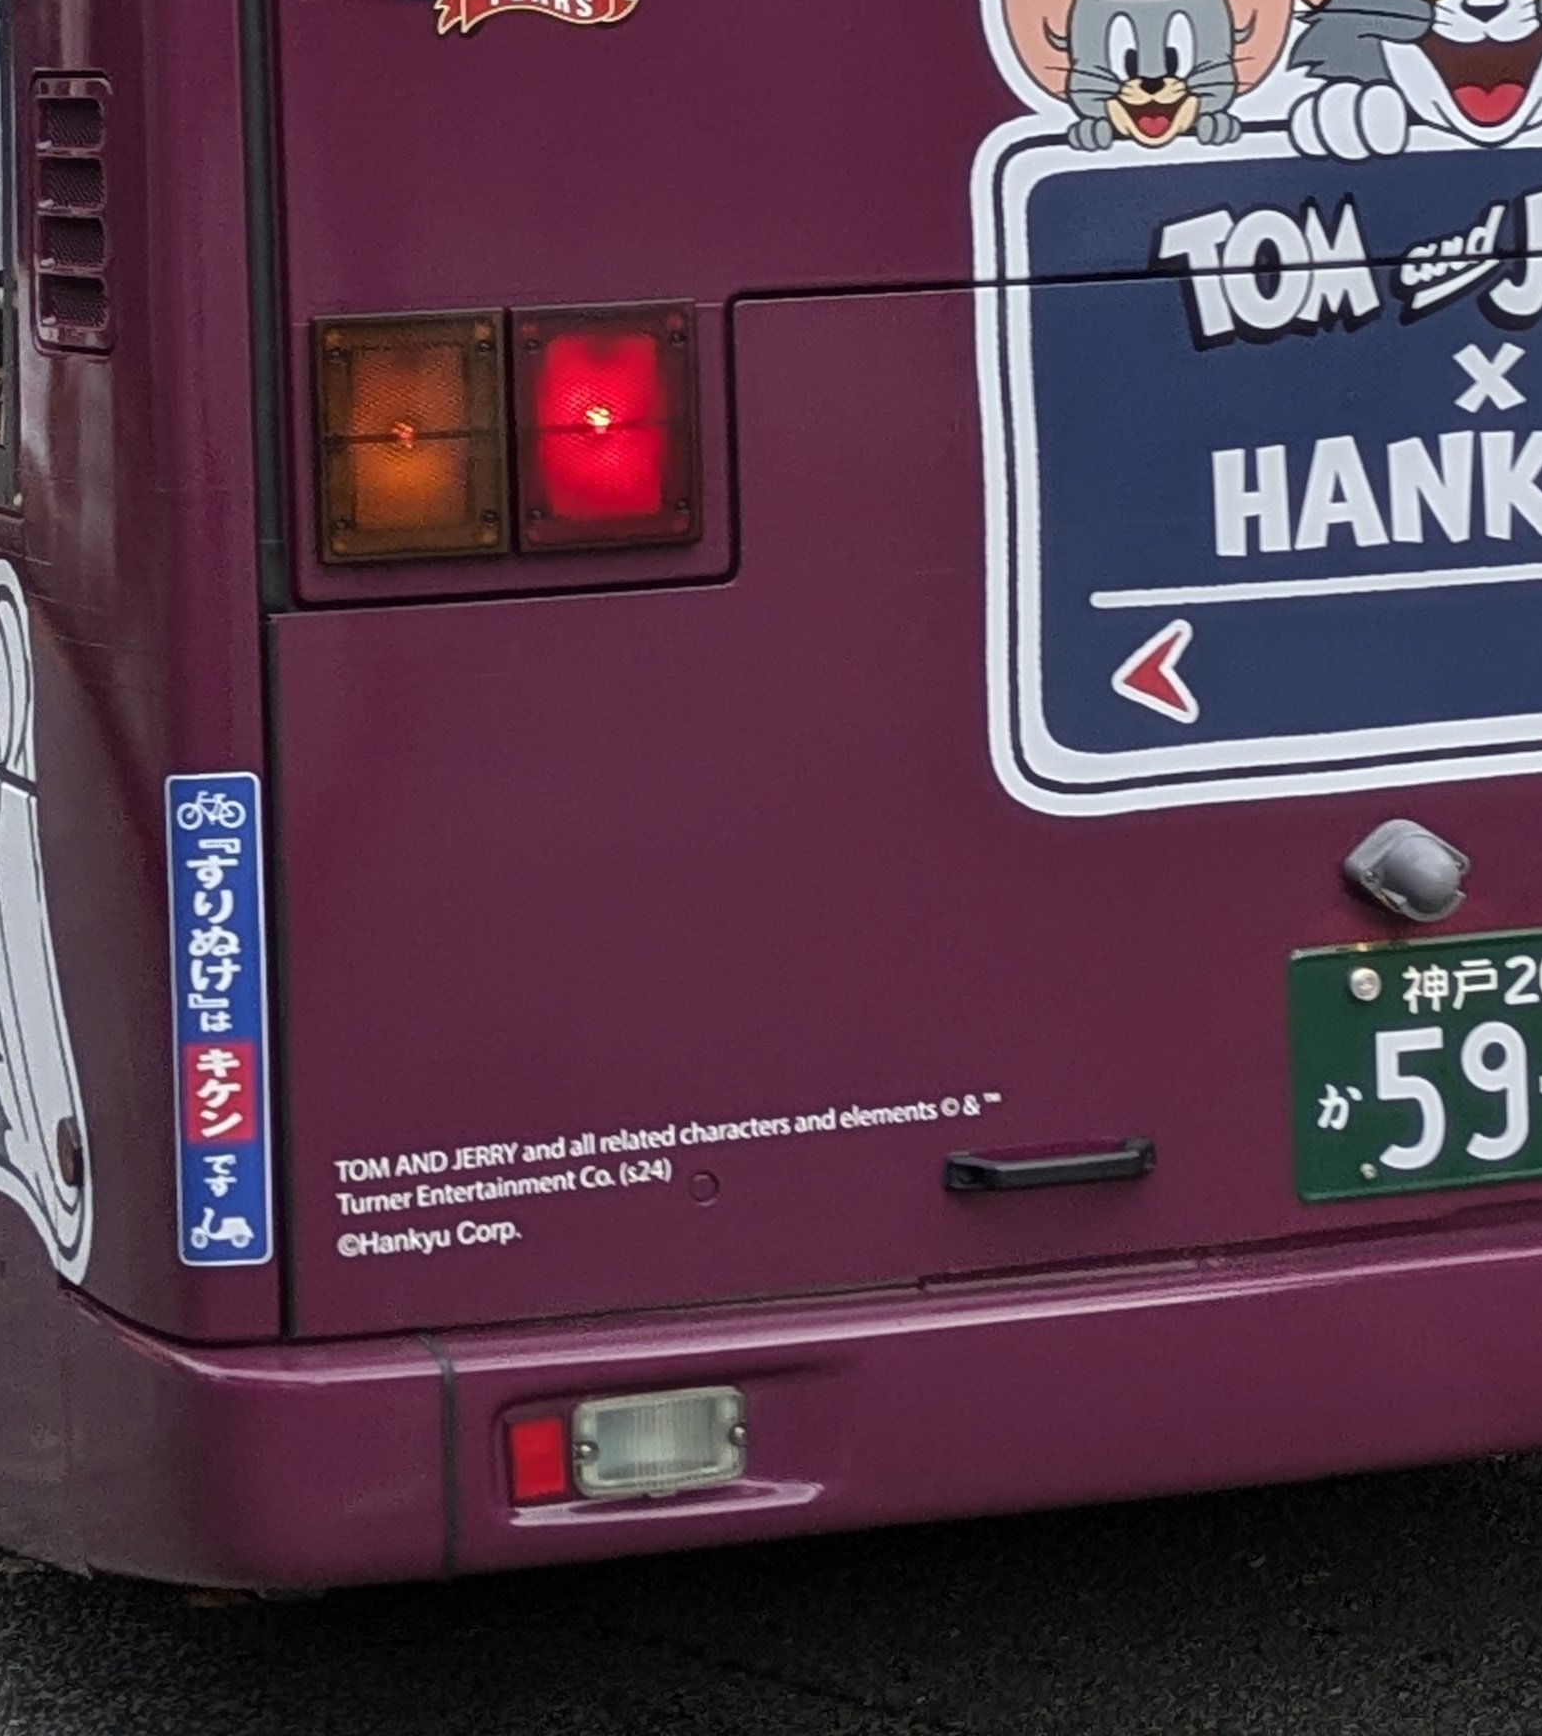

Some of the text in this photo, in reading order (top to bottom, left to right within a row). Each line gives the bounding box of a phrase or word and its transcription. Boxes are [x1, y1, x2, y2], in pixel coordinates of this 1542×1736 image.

[1153, 194, 1384, 340] TOM
[1397, 202, 1507, 310] and
[1316, 1084, 1364, 1131] か
[334, 1156, 390, 1182] TOM
[394, 1151, 449, 1177] AND
[451, 1142, 519, 1171] JERRY
[522, 1135, 566, 1163] and
[569, 1132, 596, 1157] all
[600, 1124, 676, 1153] related
[679, 1121, 792, 1146] characters
[794, 1107, 837, 1133] and
[839, 1100, 939, 1130] elements
[335, 1157, 673, 1216] Turner Entertainment Co. (s24)
[456, 1220, 523, 1247] Corp.
